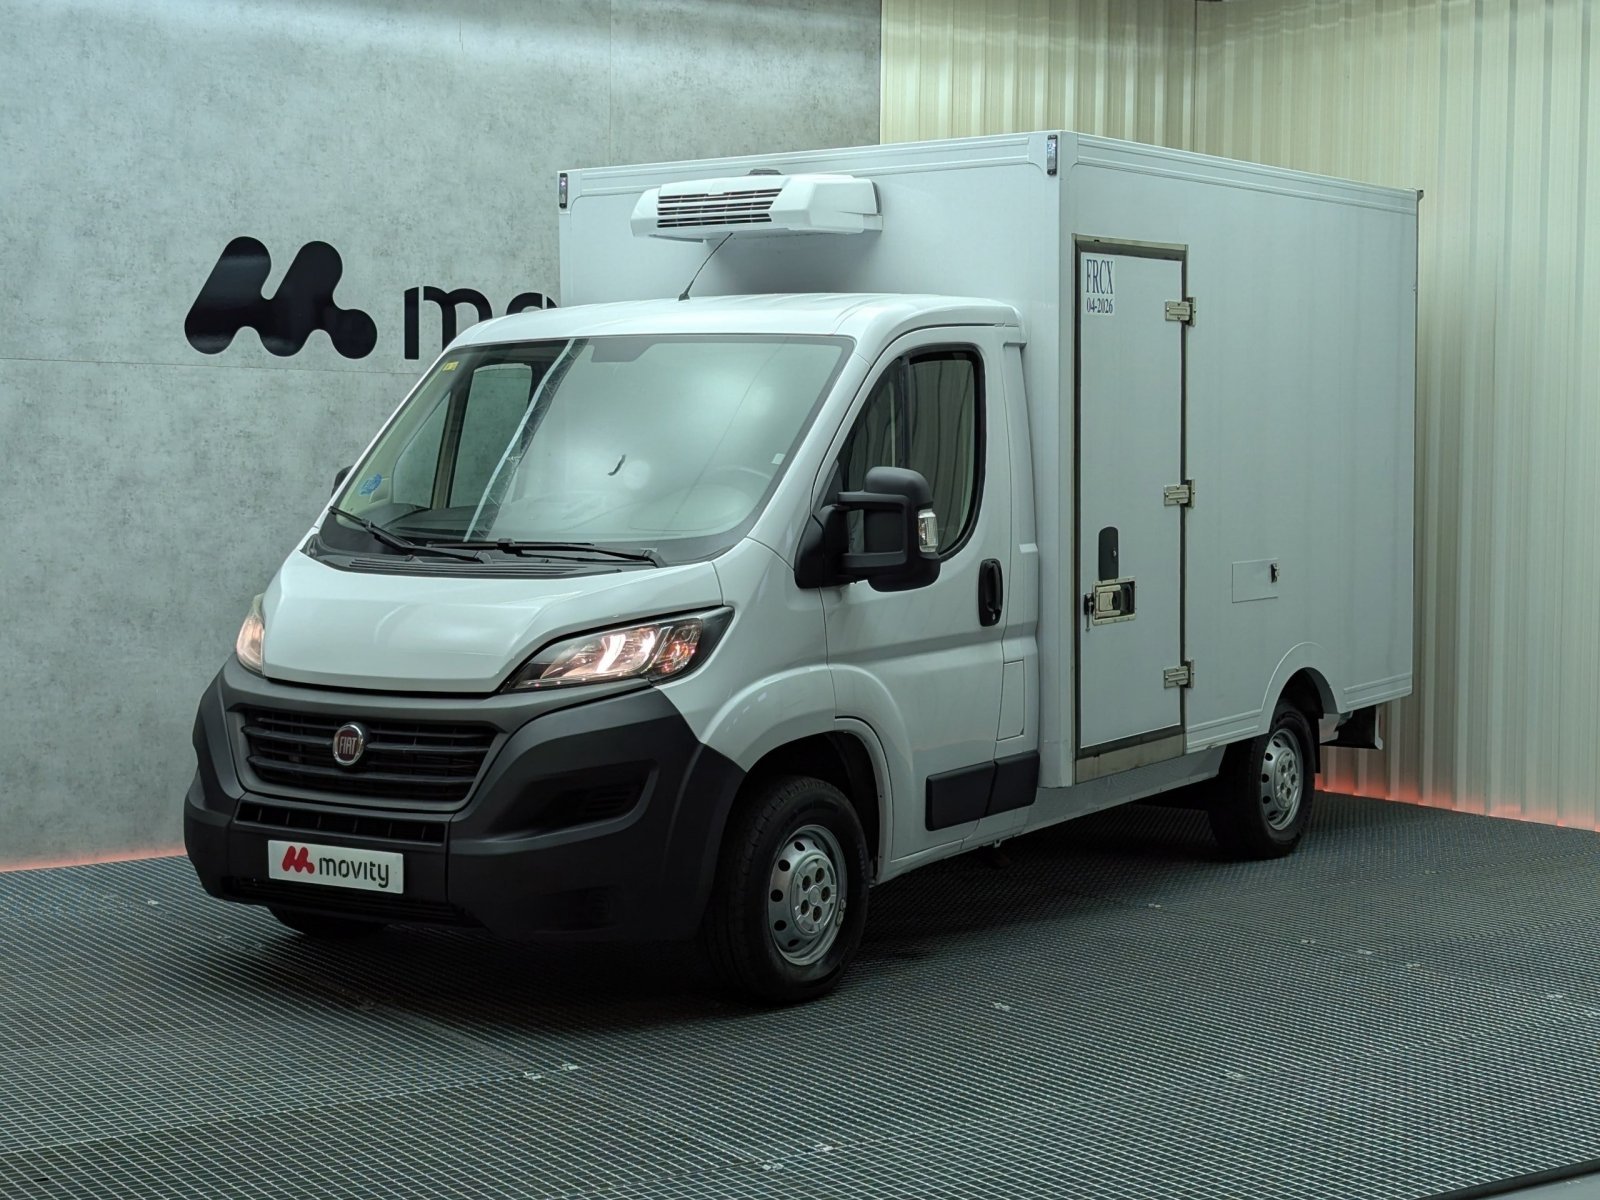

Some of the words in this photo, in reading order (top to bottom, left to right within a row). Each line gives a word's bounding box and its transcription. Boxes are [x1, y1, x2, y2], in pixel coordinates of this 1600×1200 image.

[1086, 259, 1113, 294] FRCX
[1086, 297, 1113, 313] 04-2026
[339, 736, 357, 755] FIAT
[319, 857, 389, 888] movity
